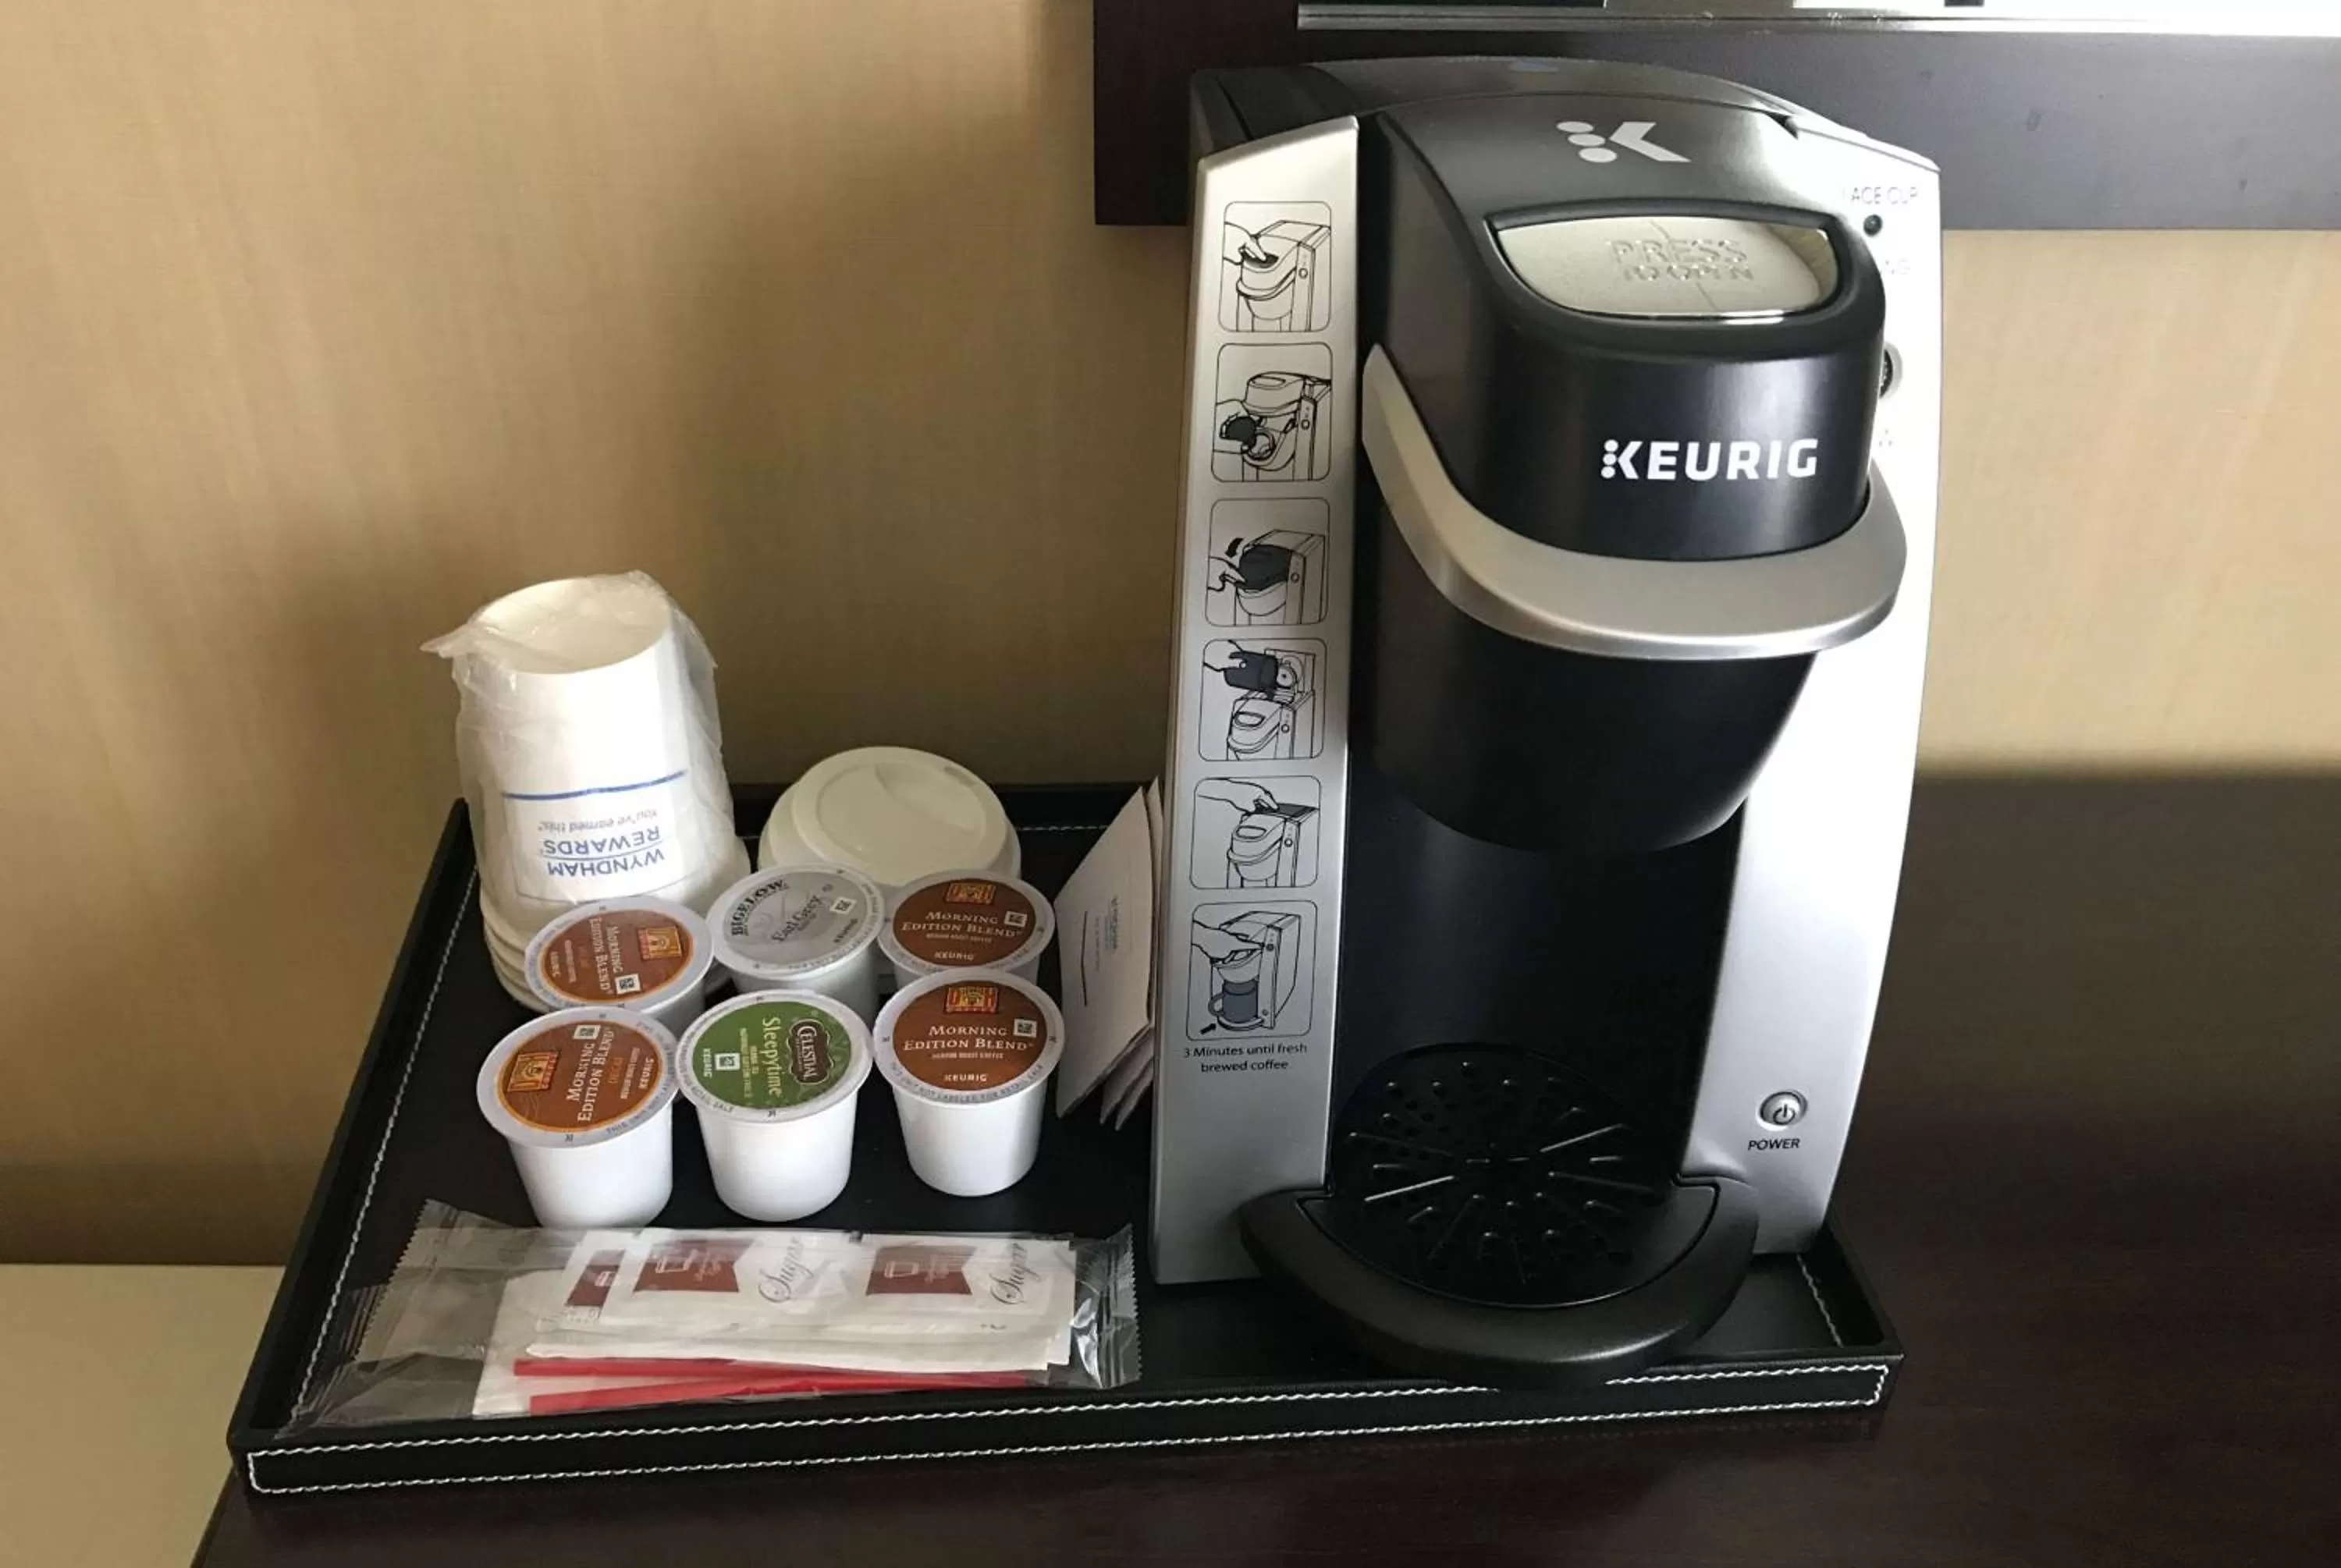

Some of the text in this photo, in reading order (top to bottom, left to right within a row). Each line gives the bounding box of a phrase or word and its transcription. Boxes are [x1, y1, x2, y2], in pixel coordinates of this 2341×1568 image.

[1610, 239, 1748, 264] PRESS
[1600, 438, 1818, 481] KEURIG
[542, 826, 661, 856] REWARDS
[548, 848, 665, 877] WYNDHAM
[730, 878, 790, 936] BIGELOW
[925, 910, 1000, 924] MORNING
[901, 921, 1015, 937] EDITION BLEND
[606, 925, 623, 974] MORNING
[595, 954, 611, 991] BLEND
[903, 1038, 1027, 1051] EDITION BLEND
[928, 1026, 1007, 1036] MORNING
[760, 1016, 785, 1098] Sleepytime
[796, 1025, 819, 1080] CELESTIAL
[1184, 1043, 1307, 1058] 3 Minutes until fresh
[566, 1042, 595, 1102] MORNING
[577, 1028, 614, 1122] EDITION BLEND
[943, 1073, 987, 1082] KEURIG
[1201, 1059, 1289, 1073] brewed coffee
[1747, 1138, 1801, 1151] POWER
